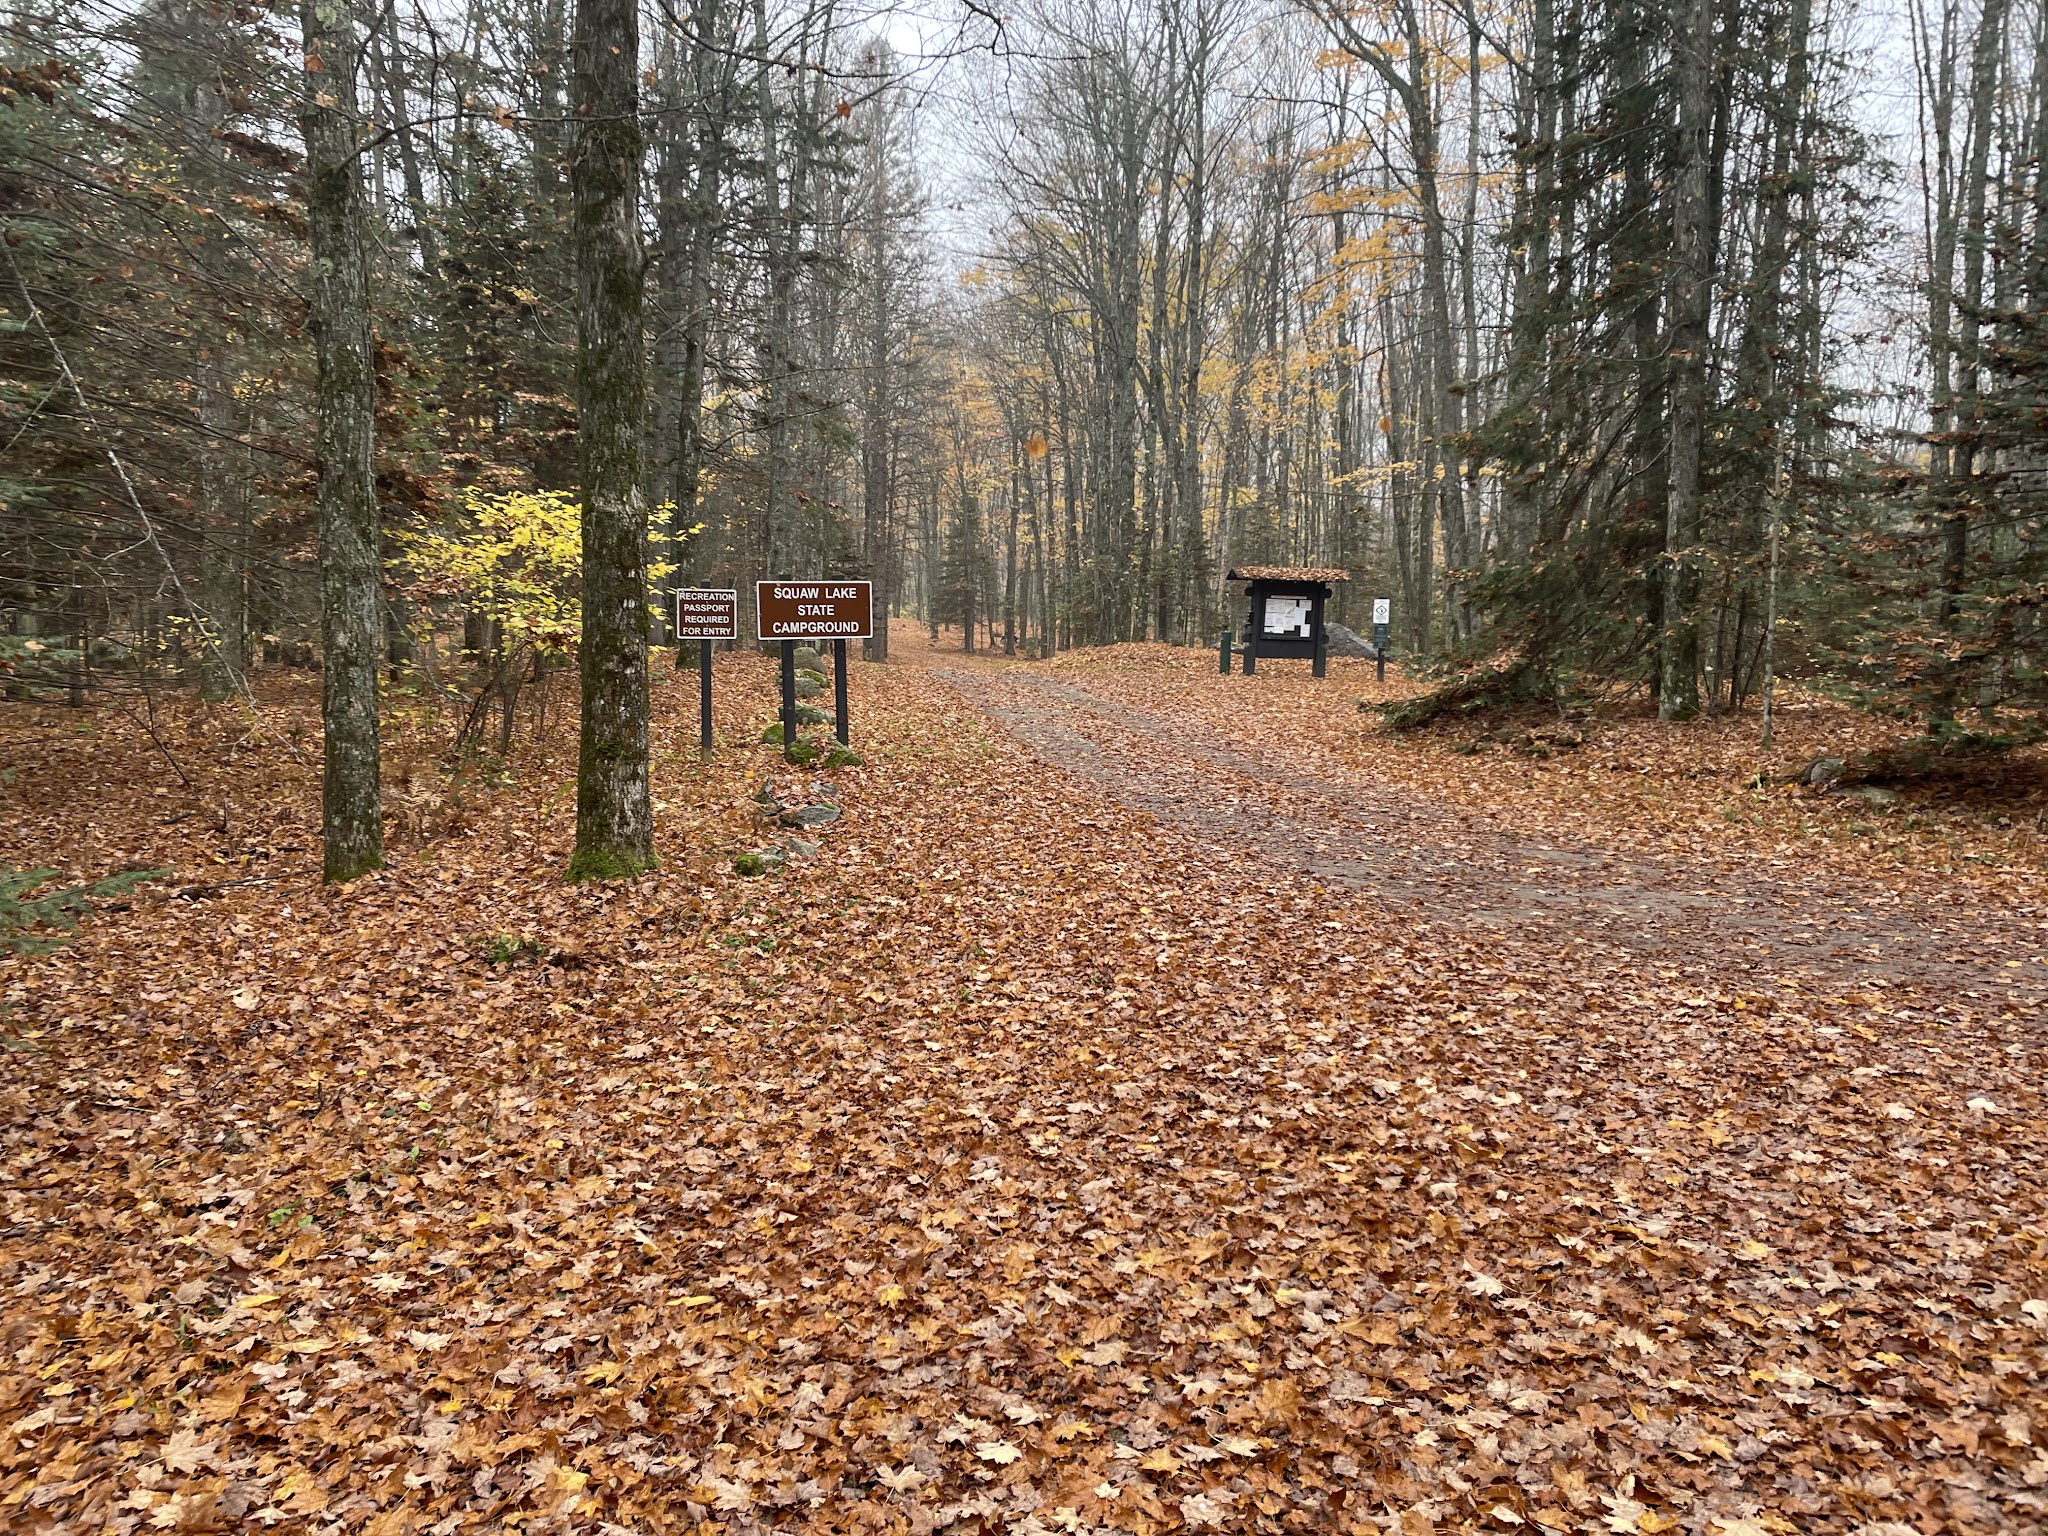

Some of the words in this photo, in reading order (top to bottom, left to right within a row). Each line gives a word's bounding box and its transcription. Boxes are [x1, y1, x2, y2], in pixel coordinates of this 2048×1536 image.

[680, 592, 734, 600] RECREATION
[774, 588, 818, 599] SQUAW
[826, 588, 856, 598] LAKE
[684, 604, 730, 612] PASSPORT
[798, 605, 834, 615] STATE
[773, 622, 859, 633] CAMPGROUND
